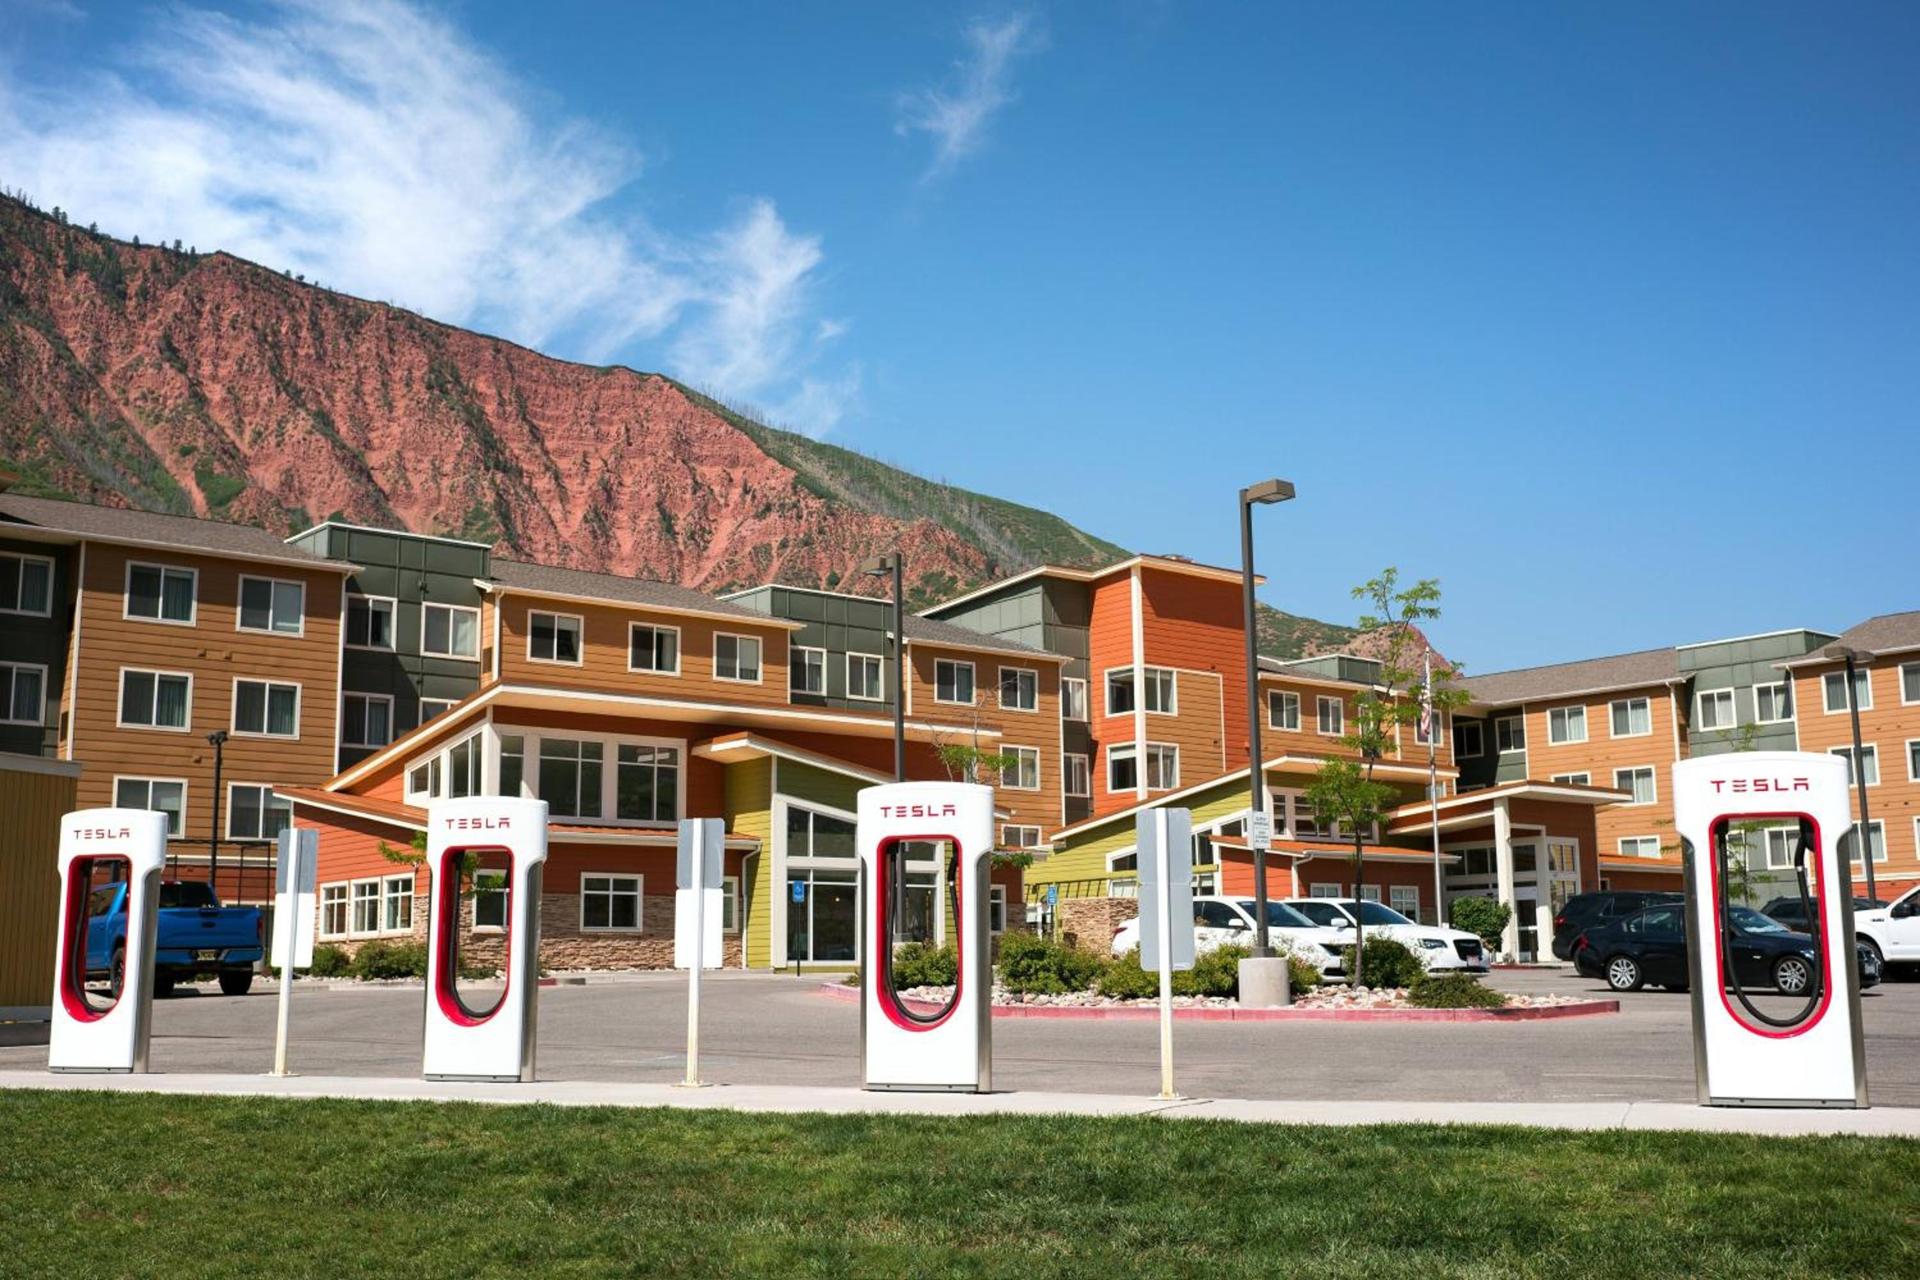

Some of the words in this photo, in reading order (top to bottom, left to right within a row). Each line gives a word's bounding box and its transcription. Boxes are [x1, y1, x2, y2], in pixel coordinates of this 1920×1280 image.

[1710, 777, 1809, 793] TESLA
[880, 804, 956, 818] TESLA
[445, 817, 511, 830] TESLA
[73, 828, 130, 840] TESLA
